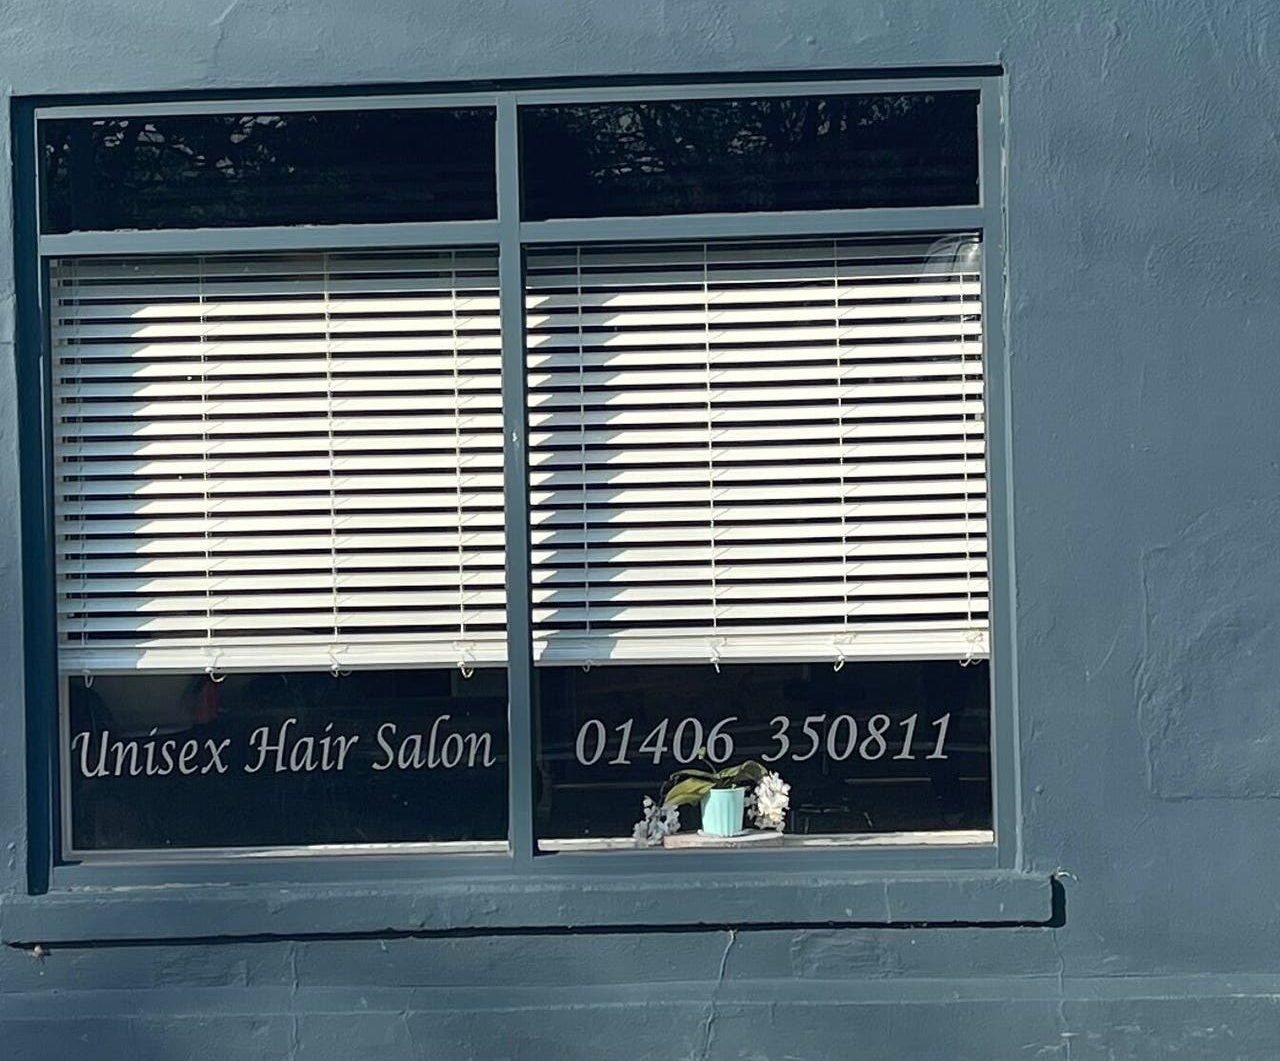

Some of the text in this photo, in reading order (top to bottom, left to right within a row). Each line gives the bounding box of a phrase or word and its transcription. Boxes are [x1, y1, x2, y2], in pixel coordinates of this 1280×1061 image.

[72, 714, 496, 778] Unisex Hair Salon
[575, 712, 951, 766] 01406 350811
